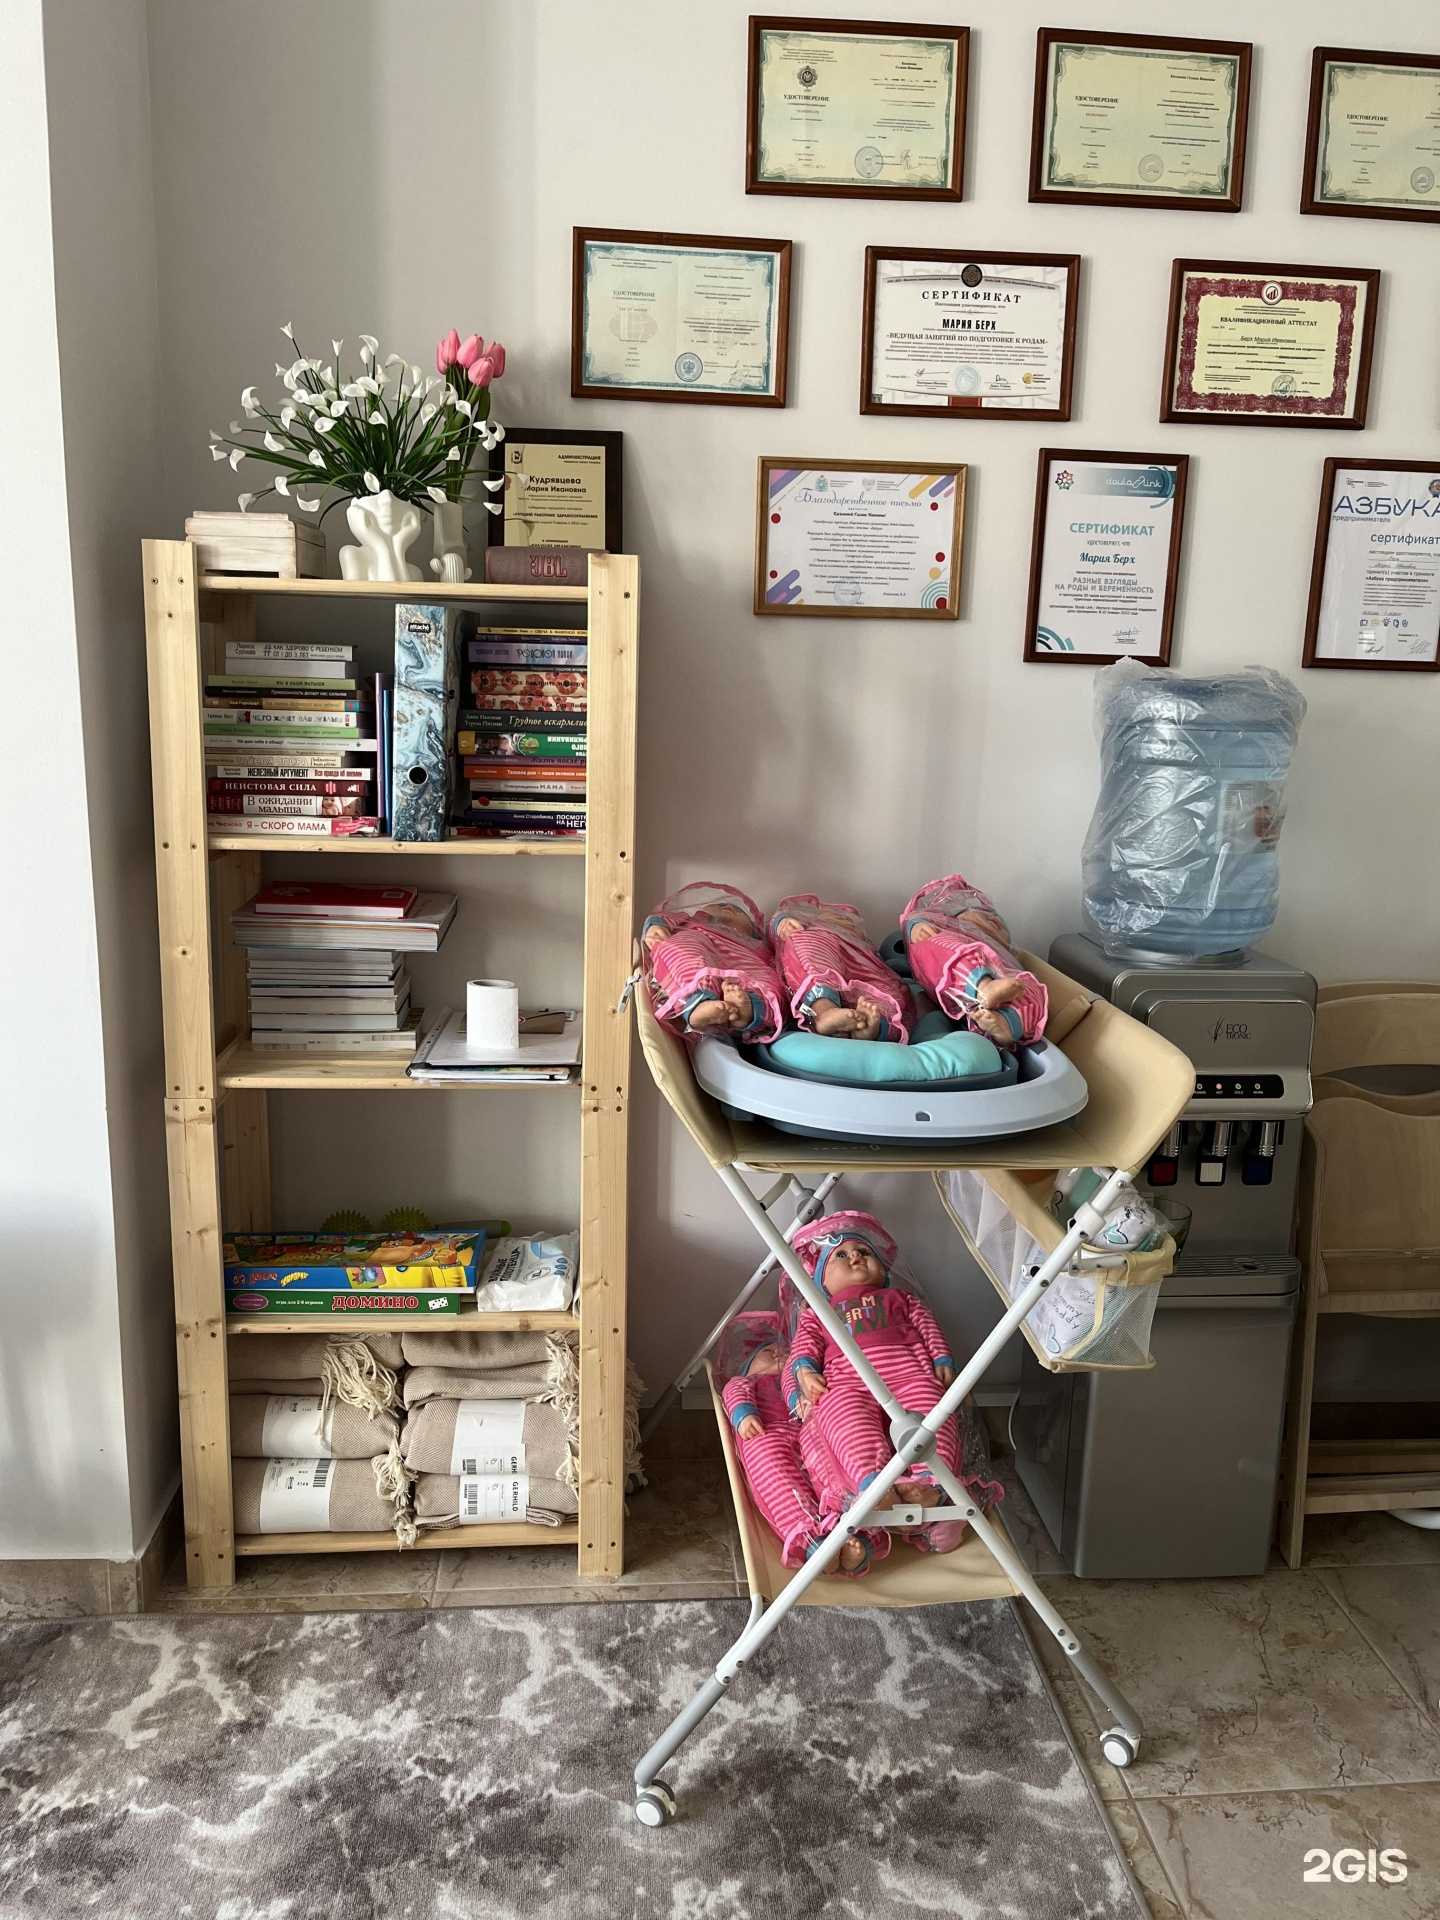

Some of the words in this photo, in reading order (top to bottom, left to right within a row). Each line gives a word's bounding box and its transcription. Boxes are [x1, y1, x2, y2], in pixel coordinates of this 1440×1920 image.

[921, 290, 1022, 304] СЕРТИФИКАТ
[942, 318, 972, 330] МАРИЯ
[975, 319, 997, 330] БЕРХ
[969, 335, 1014, 344] ПОДГОТОВКЕ
[529, 476, 581, 485] Кудрявцева
[551, 486, 587, 494] Ивановна
[1070, 522, 1155, 536] СЕРТИФИКАТ
[1370, 533, 1440, 547] сертификат
[1080, 552, 1111, 565] Мария
[1112, 553, 1136, 566] Берх
[1072, 577, 1102, 585] РАЗНЫЕ
[1104, 578, 1138, 586] ВЗГЛЯДЫ
[1068, 584, 1089, 592] РОДЫ
[1099, 585, 1154, 594] БЕРЕМЕННОСТЬ
[509, 715, 541, 728] Грудное
[247, 767, 279, 777] ЖЕЛЕЗНЫЙ
[280, 768, 309, 777] АРГУМЕНТ
[225, 782, 287, 791] НЕИСТОВАЯ
[289, 783, 317, 792] СИЛА
[247, 796, 255, 805] В
[258, 796, 313, 806] ожидании
[258, 806, 302, 814] малыша
[246, 821, 253, 829] Я
[260, 821, 295, 831] СКОРО
[297, 822, 327, 832] МАМА
[1226, 1023, 1249, 1033] ECO
[331, 1295, 419, 1311] ДОМИНО
